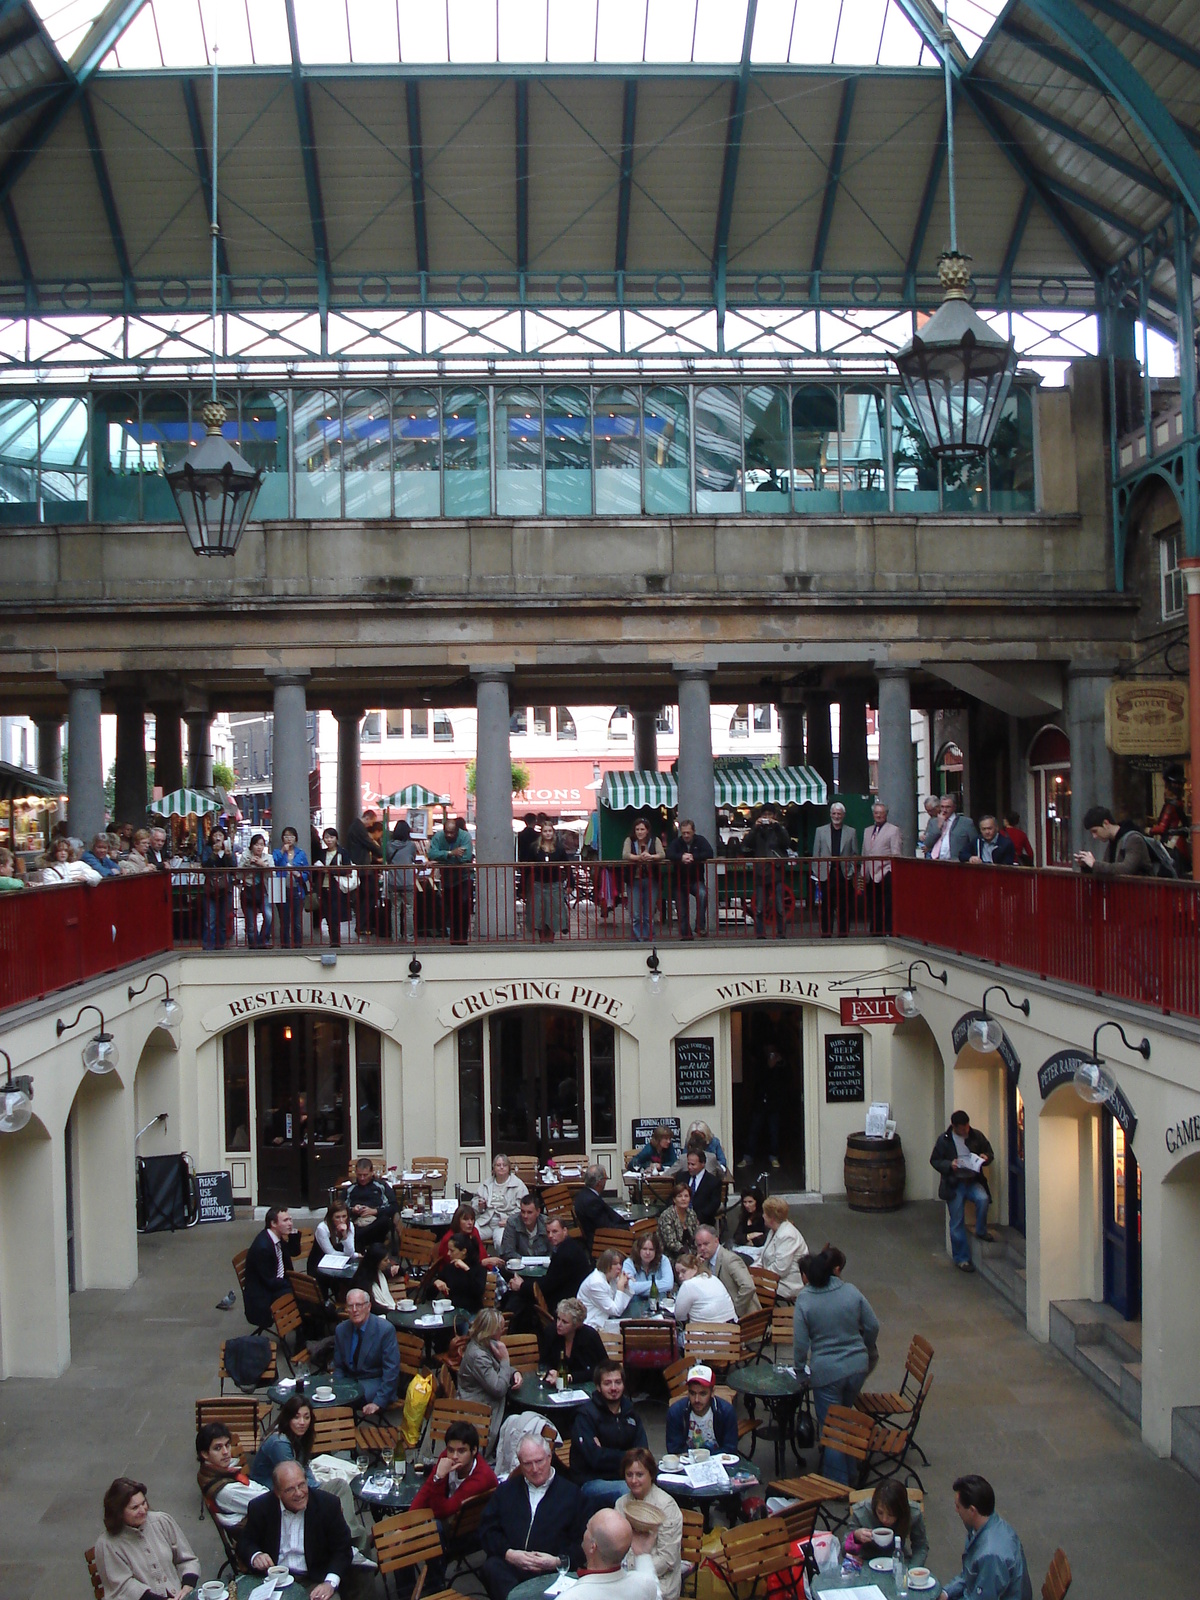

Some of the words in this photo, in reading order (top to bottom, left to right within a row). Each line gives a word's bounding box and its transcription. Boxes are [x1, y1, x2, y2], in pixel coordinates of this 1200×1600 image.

[517, 789, 581, 800] TONS
[716, 978, 767, 1000] WINE
[778, 978, 819, 998] BAR
[228, 988, 371, 1017] RESTAURANT
[451, 981, 561, 1019] CRUSTING
[570, 985, 623, 1019] PIPE
[851, 1000, 895, 1016] EXIT
[677, 1043, 690, 1052] FINE
[829, 1039, 846, 1048] RIBS
[848, 1039, 858, 1047] OF
[834, 1046, 855, 1054] BEEF
[678, 1052, 710, 1061] WINES
[828, 1053, 861, 1063] STEAKS
[688, 1061, 711, 1070] RARE
[680, 1070, 710, 1079] PORTS
[828, 1070, 862, 1078] CHEESES
[1040, 1062, 1059, 1088] PETER
[678, 1086, 713, 1094] VINTAGES
[832, 1088, 857, 1096] COFFEE
[198, 1177, 218, 1187] PLEASE
[199, 1187, 213, 1197] USE
[200, 1197, 219, 1207] OTHER
[201, 1205, 232, 1217] ENTRANCE
